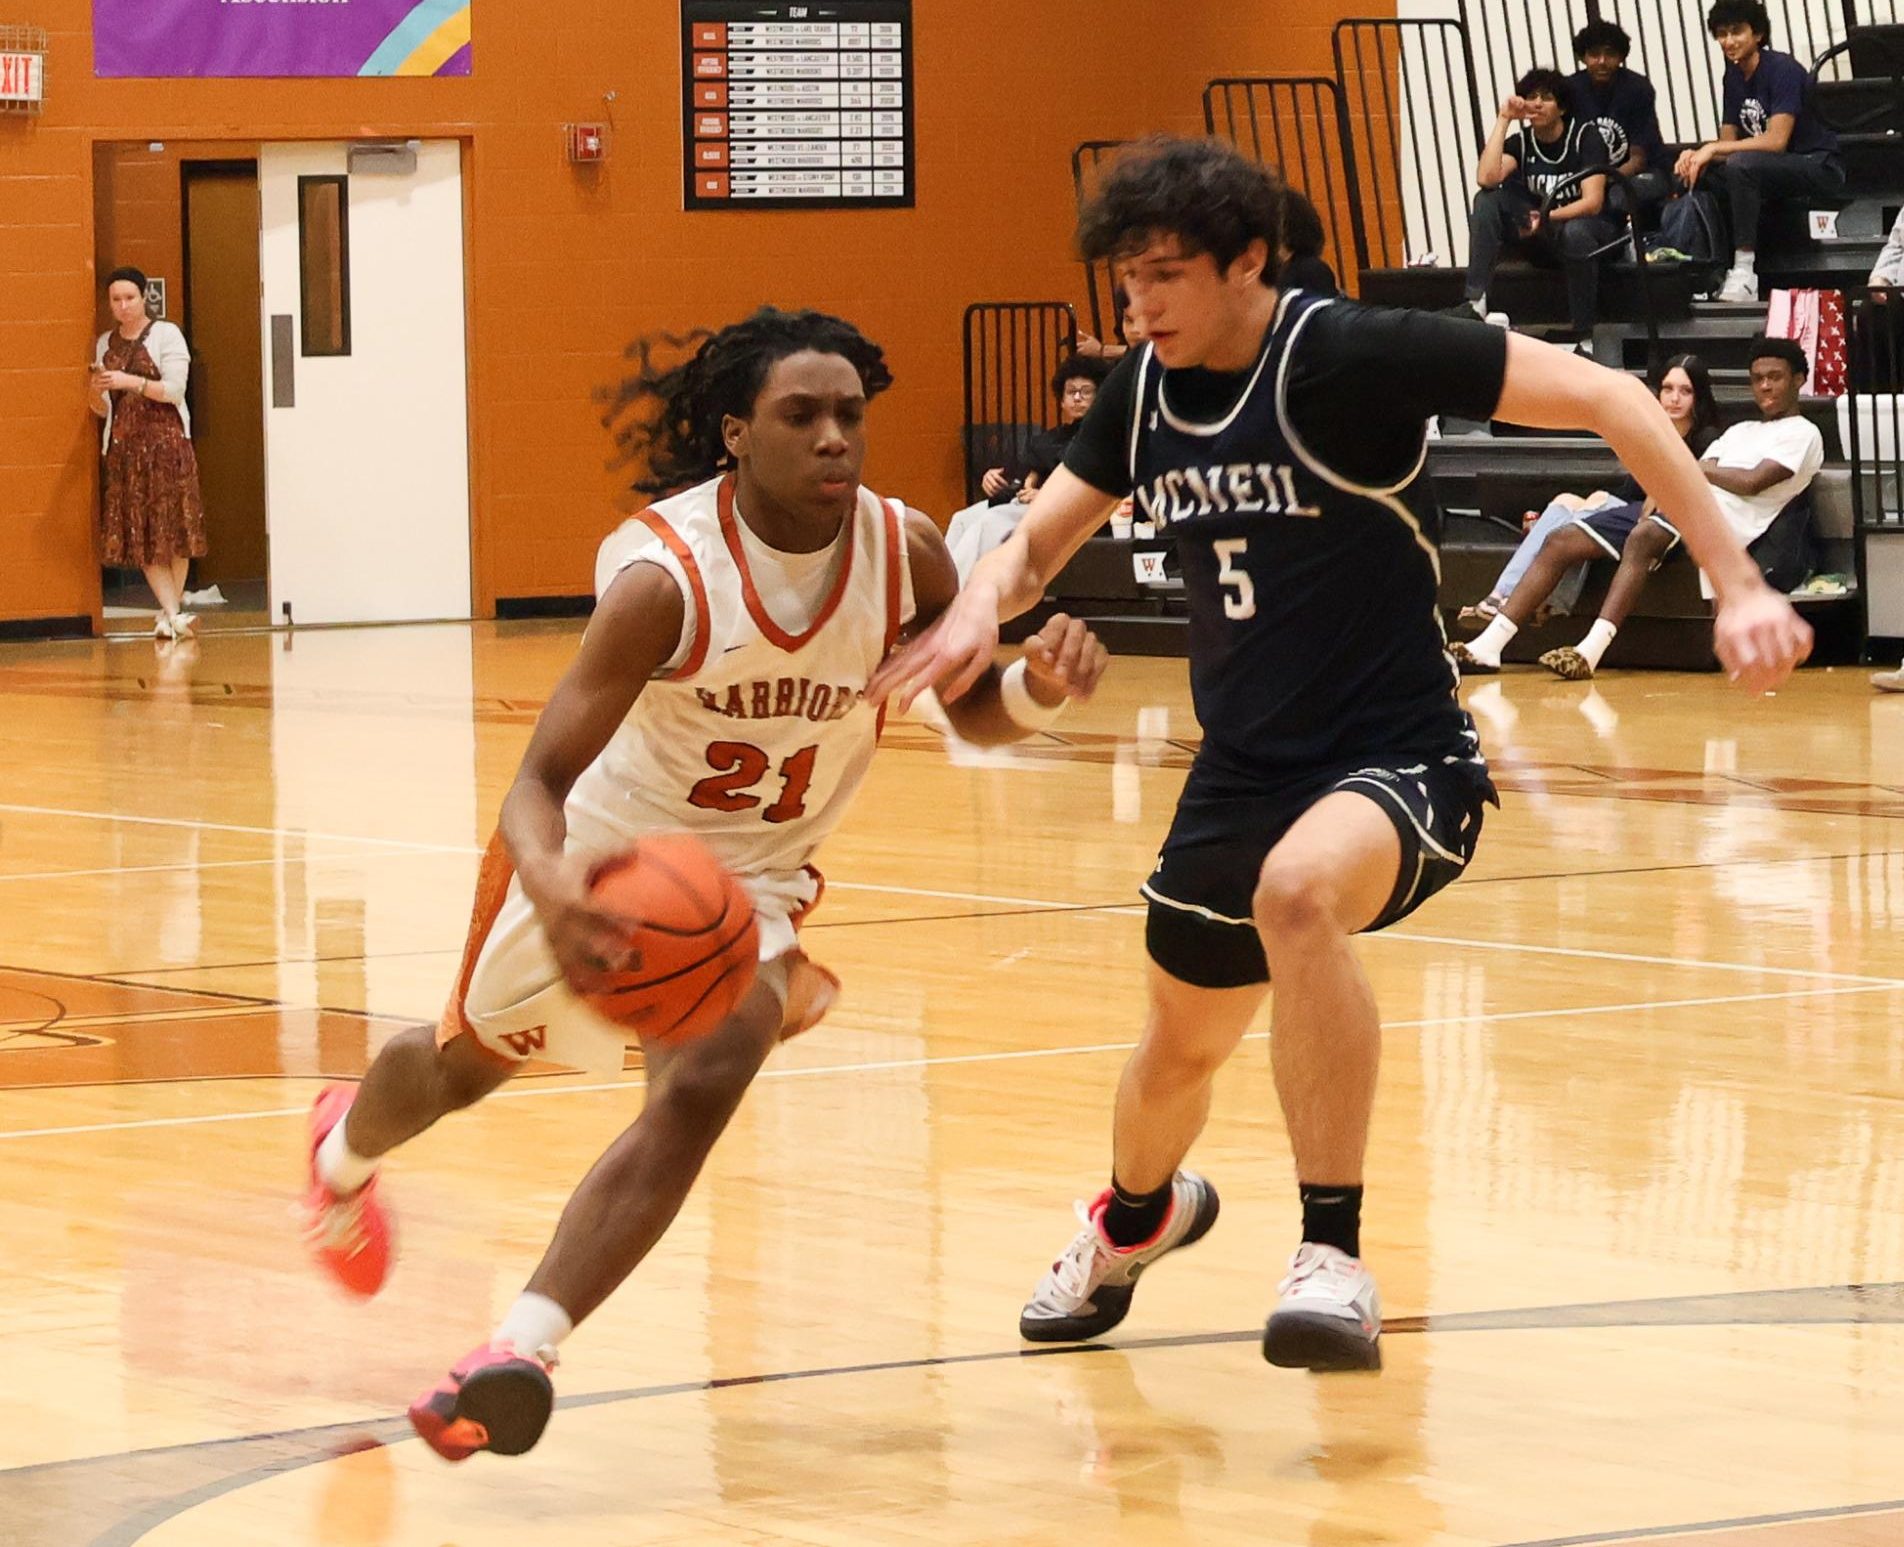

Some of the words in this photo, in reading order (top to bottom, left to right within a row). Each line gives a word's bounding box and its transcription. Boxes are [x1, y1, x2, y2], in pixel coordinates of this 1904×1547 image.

[1, 55, 33, 94] XIT
[1816, 216, 1829, 229] W
[1141, 557, 1156, 573] W
[1213, 538, 1257, 620] 5
[687, 740, 819, 823] 21
[497, 1024, 547, 1056] W
